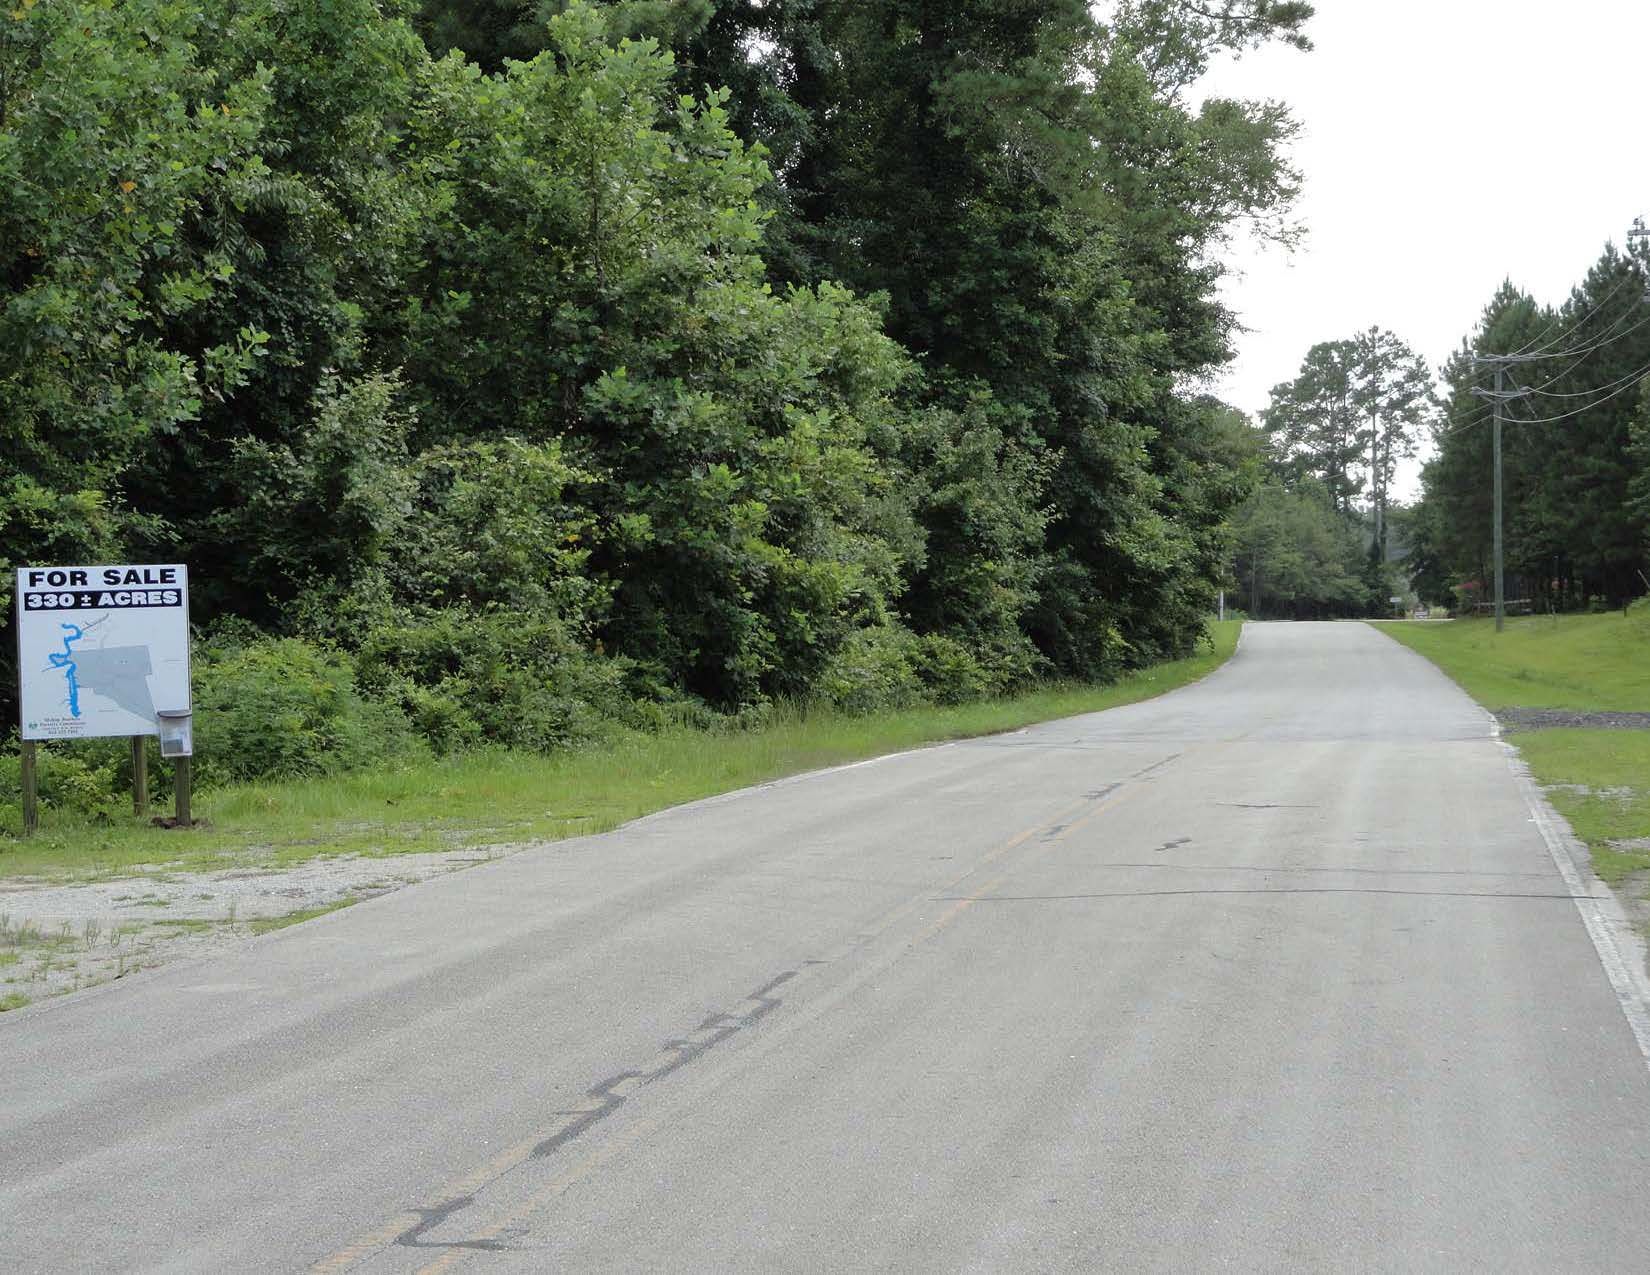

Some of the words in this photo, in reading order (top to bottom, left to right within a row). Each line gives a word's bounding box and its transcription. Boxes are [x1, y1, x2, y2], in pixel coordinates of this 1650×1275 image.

[29, 571, 88, 587] FOR
[103, 568, 176, 585] SALE
[27, 593, 75, 608] 330
[97, 591, 178, 606] ACRES
